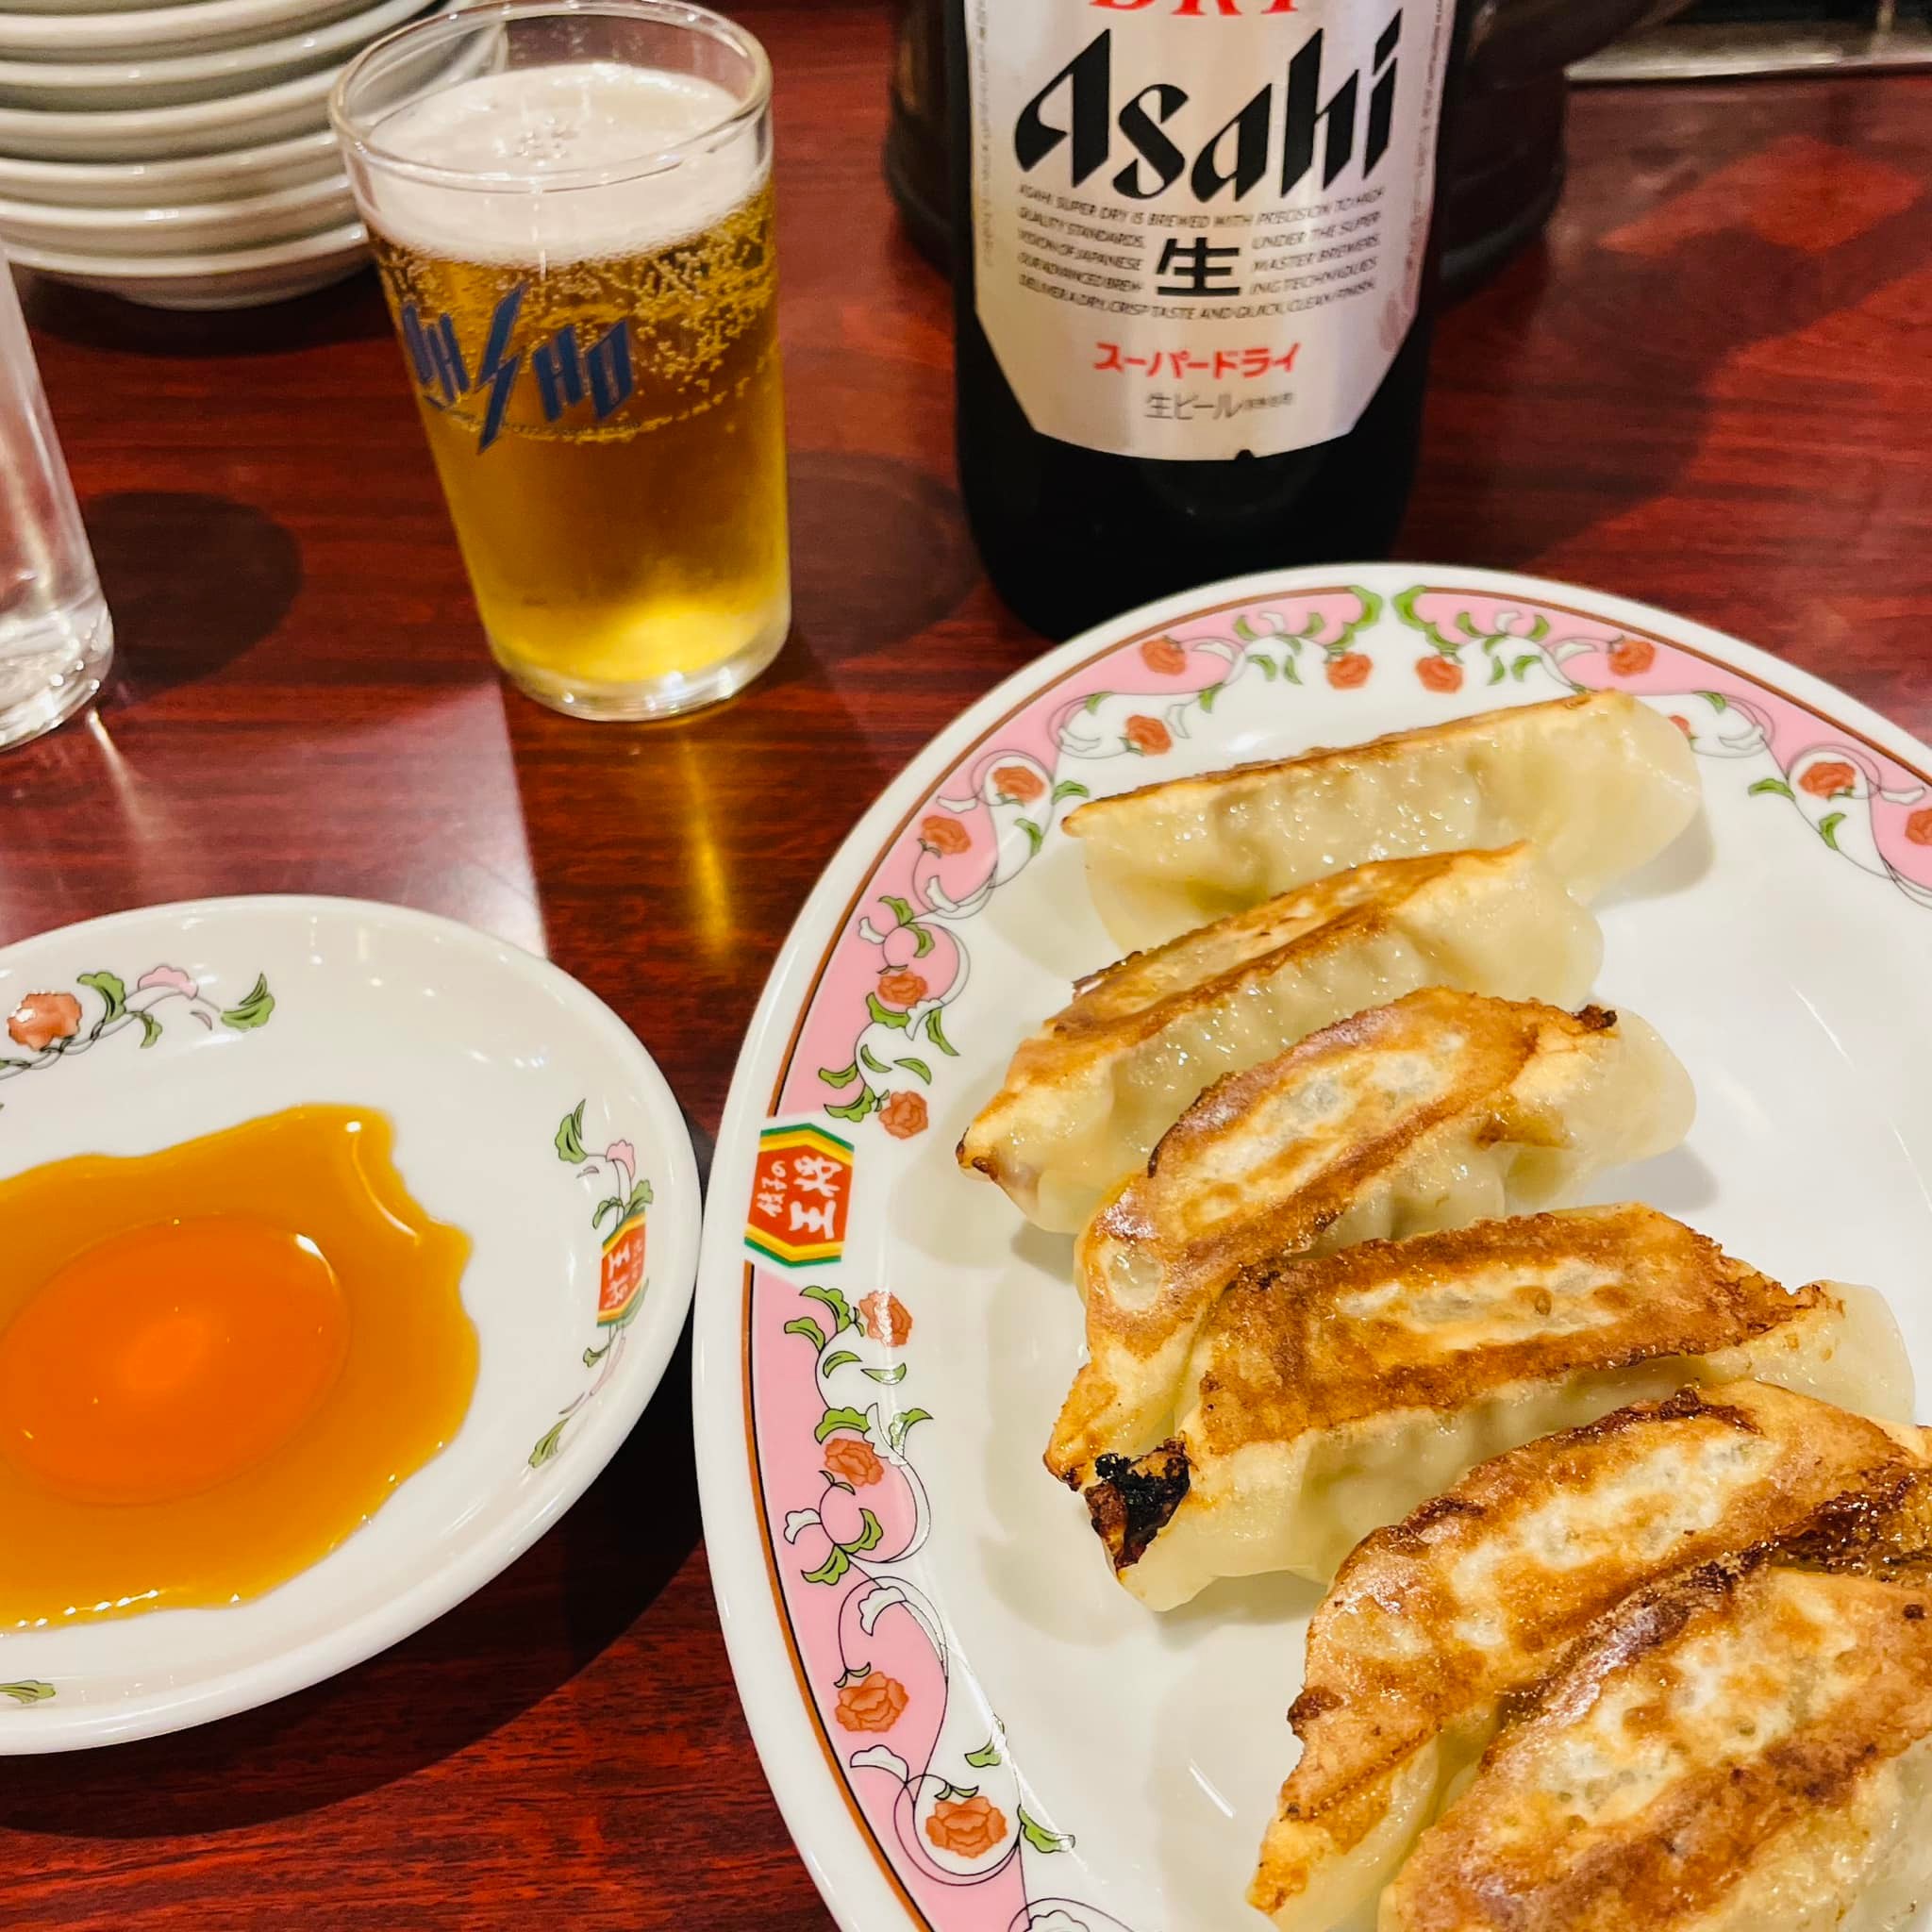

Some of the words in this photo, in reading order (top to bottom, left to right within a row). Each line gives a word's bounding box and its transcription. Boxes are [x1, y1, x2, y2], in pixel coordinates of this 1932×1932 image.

[1014, 8, 1404, 204] Asahi
[1056, 196, 1096, 216] SUPER
[1099, 207, 1127, 222] DRY
[1147, 212, 1209, 227] BREWED
[1156, 237, 1241, 297] 生
[1093, 341, 1301, 379] スーパードライ
[788, 1155, 843, 1240] 王将
